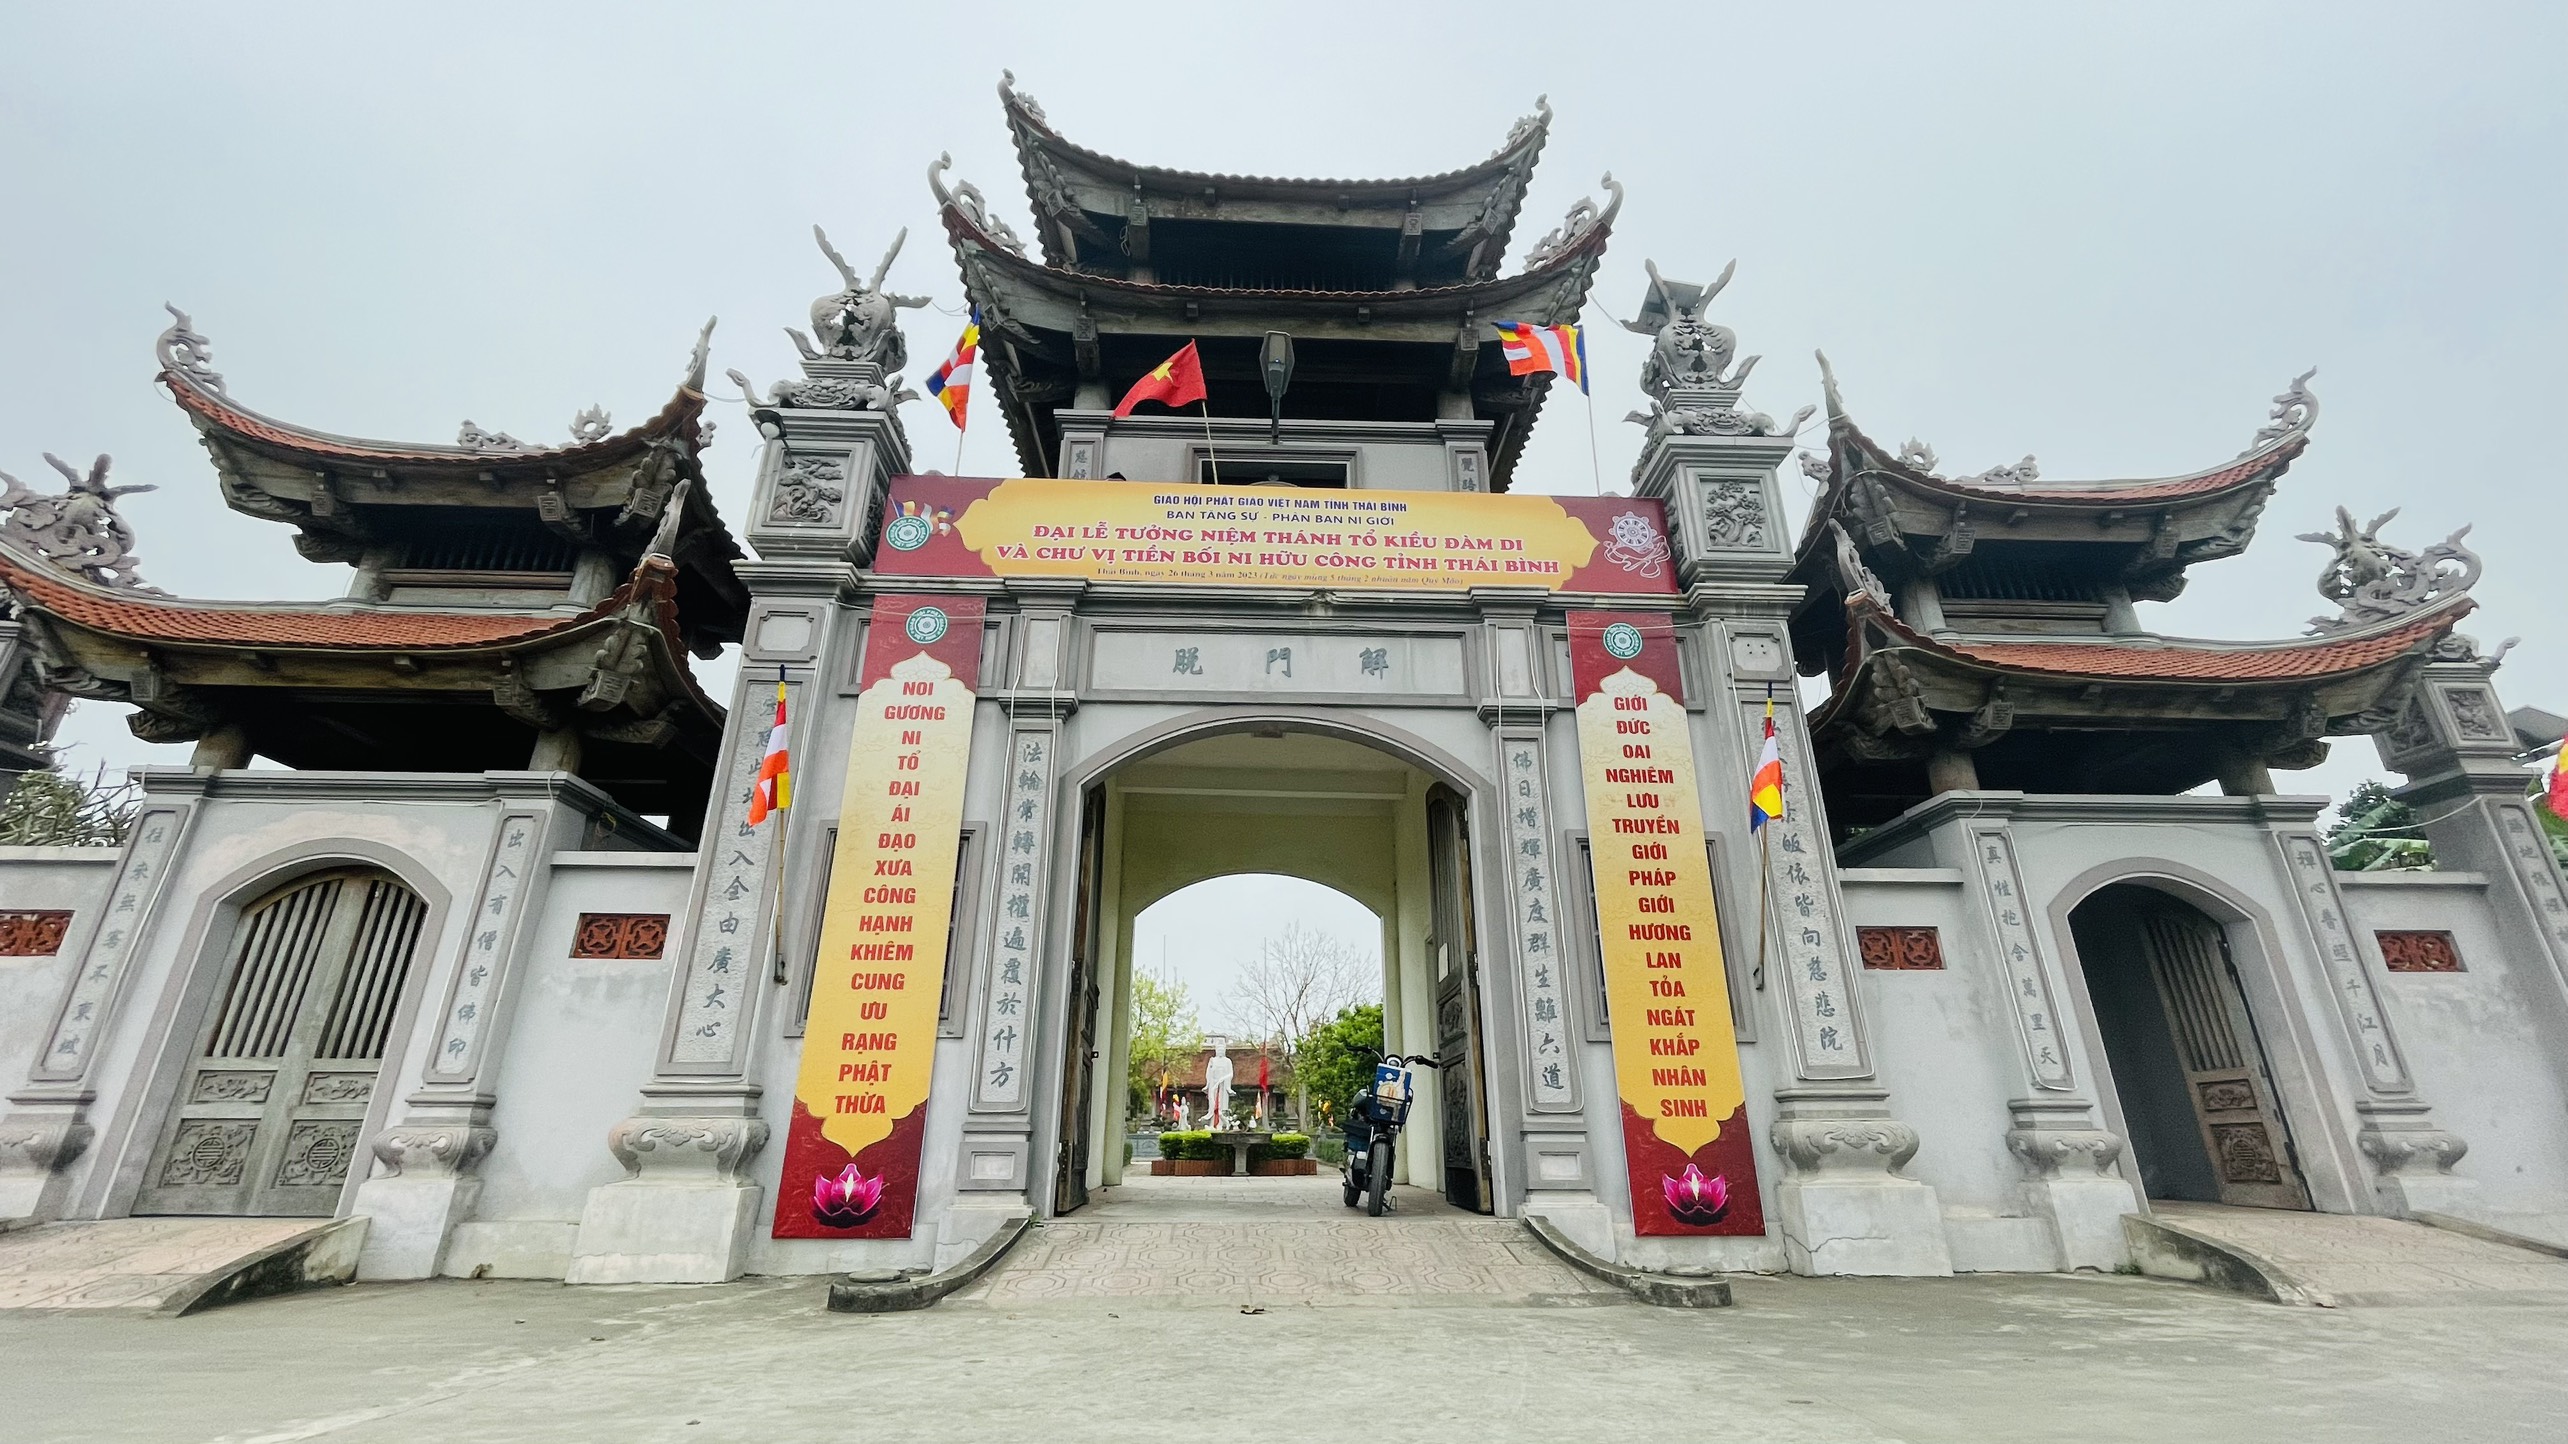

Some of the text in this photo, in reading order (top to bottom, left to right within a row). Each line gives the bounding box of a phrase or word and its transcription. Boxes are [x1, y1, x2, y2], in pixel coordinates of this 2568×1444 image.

[1294, 500, 1320, 509] NAM
[1166, 510, 1195, 519] BAN
[1240, 511, 1259, 522] SỰ
[1315, 514, 1343, 524] BAN
[1347, 516, 1362, 525] NI
[1033, 521, 1524, 551] ĐẠI LỄ TƯỞNG NIỆM THÁNH TỔ KIỀU ĐÀM DI
[996, 543, 1560, 573] VÀ CHƯ VỊ TIỀN BỐI NI HỮU CÔNG TỈNH THÁI BÌNH
[1168, 569, 1179, 577] 26
[1237, 571, 1258, 579] 2023
[902, 681, 934, 696] NOI
[884, 704, 946, 721] GƯƠNG
[1613, 694, 1648, 712] GIỚI
[1616, 717, 1651, 735] ĐỨC
[901, 730, 922, 745] NI
[897, 749, 922, 771] TỔ
[1622, 744, 1651, 759] OAI
[1605, 766, 1674, 784] NGHIÊM
[888, 780, 921, 799] ĐẠI
[1626, 792, 1660, 809] LƯU
[890, 803, 910, 822] ÁI
[1611, 814, 1680, 835] TRUYỀN
[877, 832, 917, 852] ĐẠO
[1631, 841, 1668, 860] GIỚI
[873, 859, 913, 876] XƯA
[1628, 866, 1677, 887] PHÁP
[863, 883, 916, 904] CÔNG
[1638, 893, 1675, 913] GIỚI
[858, 915, 913, 936] HẠNH
[1628, 923, 1691, 941] HƯƠNG
[850, 940, 914, 961] KHIÊM
[1646, 951, 1682, 969] LAN
[850, 973, 905, 991] CUNG
[1649, 974, 1686, 998] TỎA
[1647, 1005, 1696, 1027] NGÁT
[841, 1032, 898, 1055] RẠNG
[1650, 1032, 1700, 1056] KHẮP
[838, 1060, 892, 1086] PHẬT
[1652, 1065, 1707, 1087] NHÂN
[834, 1092, 886, 1114] THỪA
[1661, 1098, 1708, 1118] SINH
